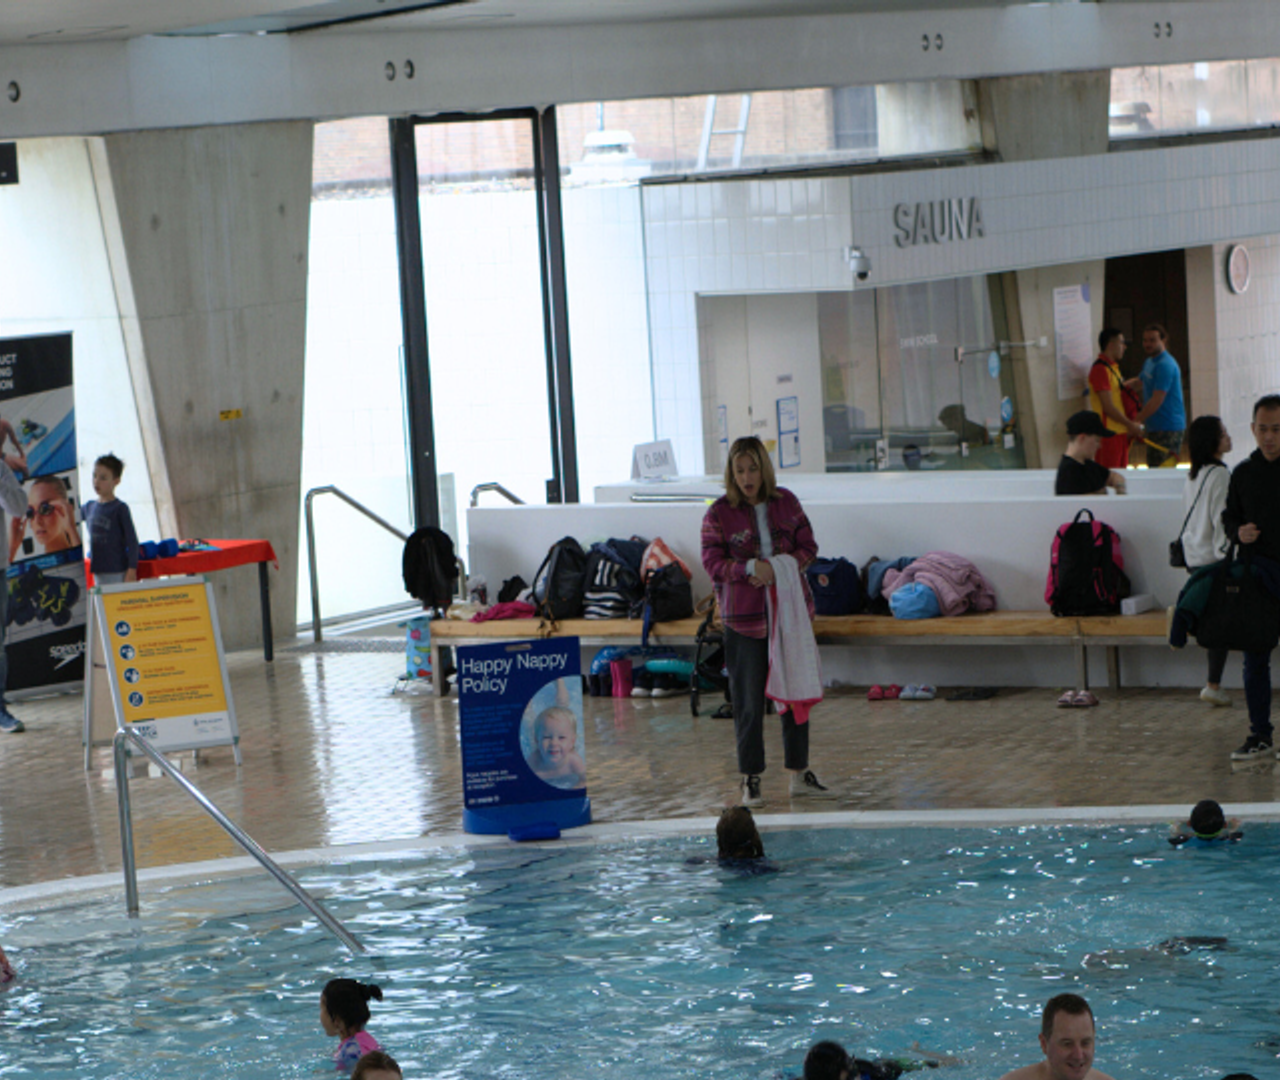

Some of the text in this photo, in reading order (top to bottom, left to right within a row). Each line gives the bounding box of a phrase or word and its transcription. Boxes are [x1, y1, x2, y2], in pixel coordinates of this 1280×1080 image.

[893, 197, 985, 249] SAUNA
[461, 652, 568, 676] Happy Nappy
[462, 676, 508, 695] Policy
